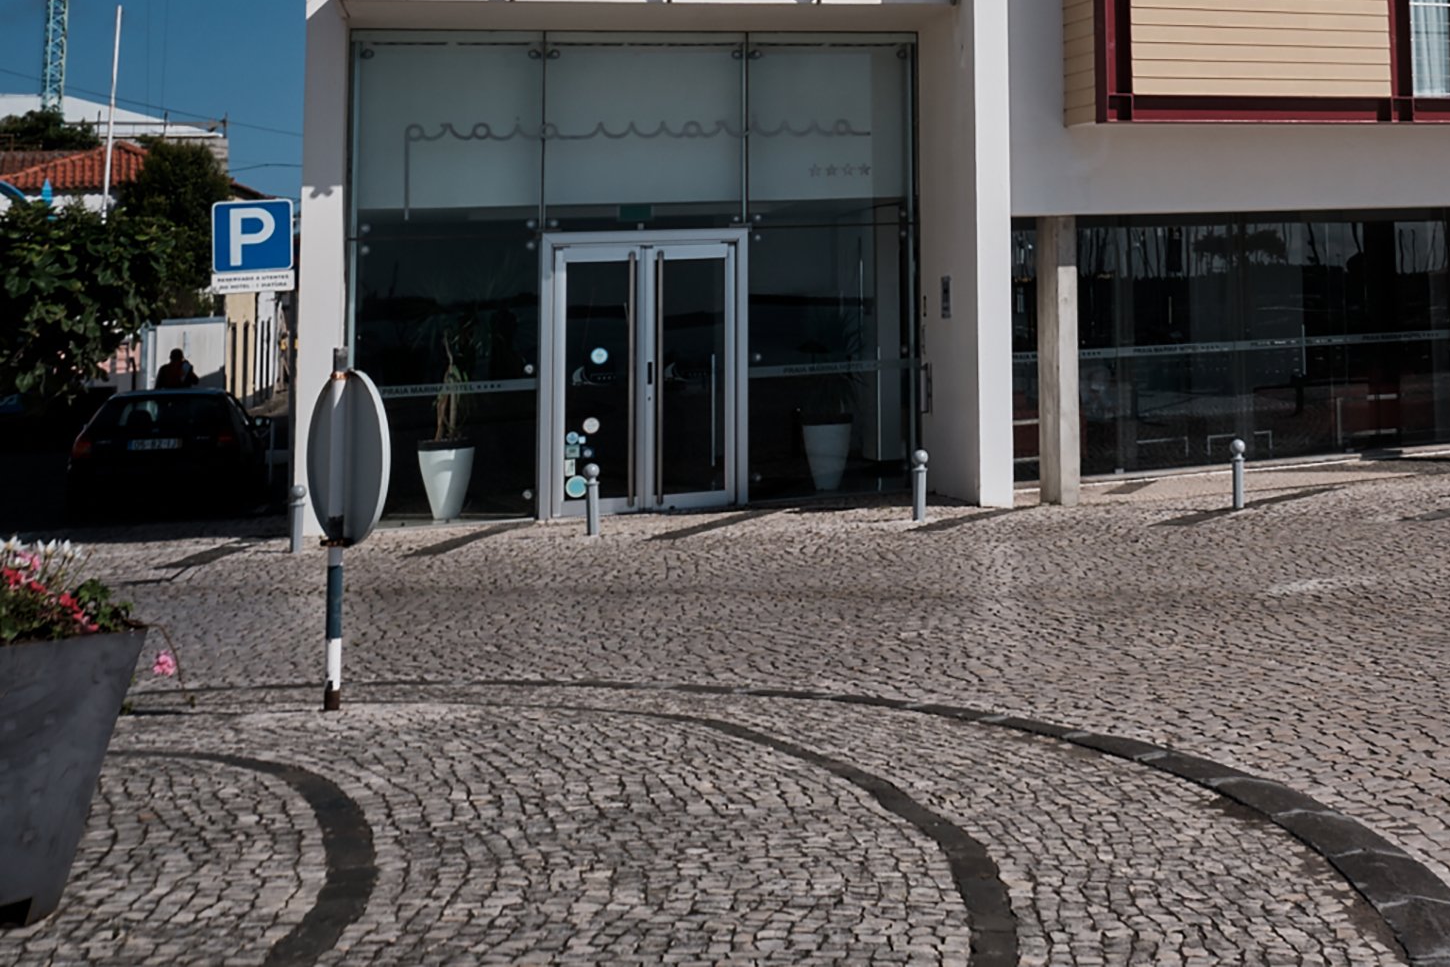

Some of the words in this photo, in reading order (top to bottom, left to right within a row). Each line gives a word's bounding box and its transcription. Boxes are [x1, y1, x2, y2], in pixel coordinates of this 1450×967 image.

[403, 117, 560, 221] praia
[582, 117, 871, 139] marina
[229, 207, 275, 267] P
[382, 387, 408, 396] PRAIA
[410, 384, 443, 394] MARINA
